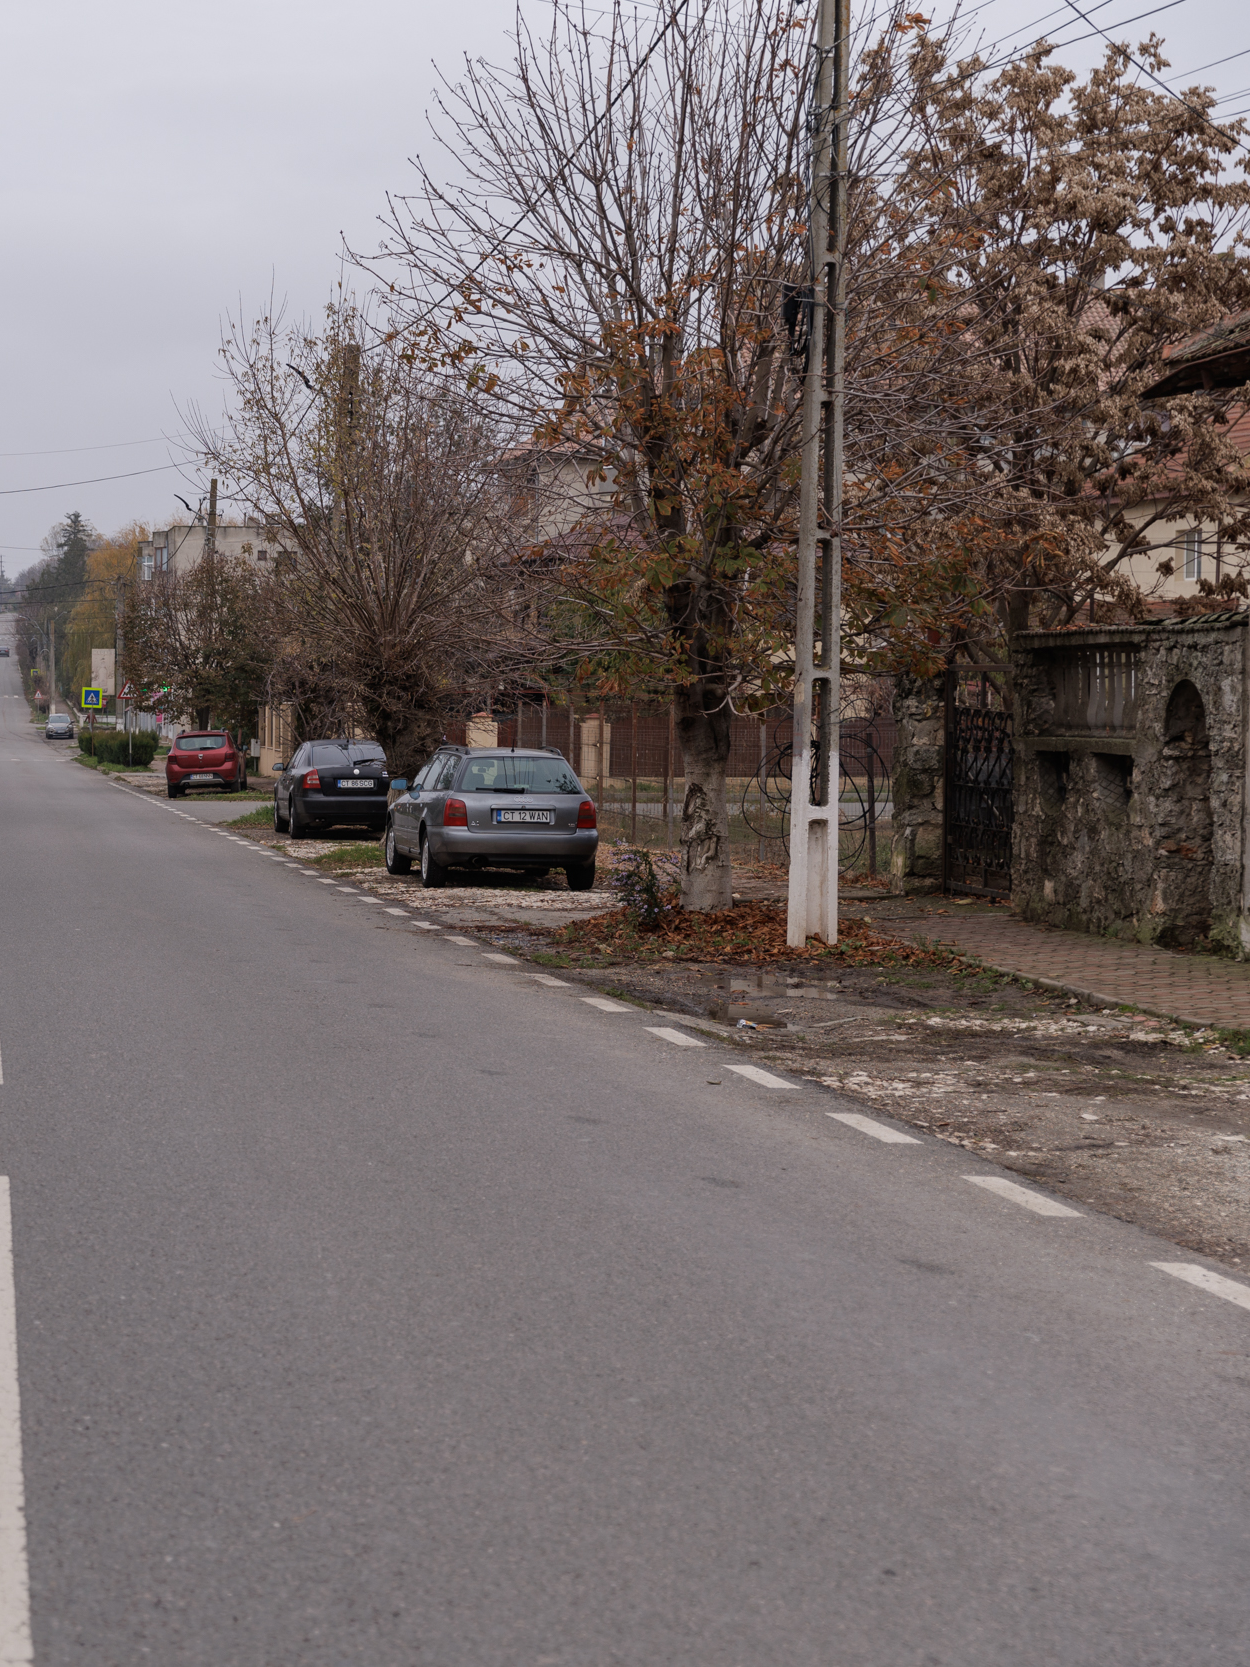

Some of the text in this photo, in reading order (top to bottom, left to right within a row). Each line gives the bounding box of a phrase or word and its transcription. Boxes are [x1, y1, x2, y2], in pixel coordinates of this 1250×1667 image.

[503, 811, 548, 821] CT 12 WAN
